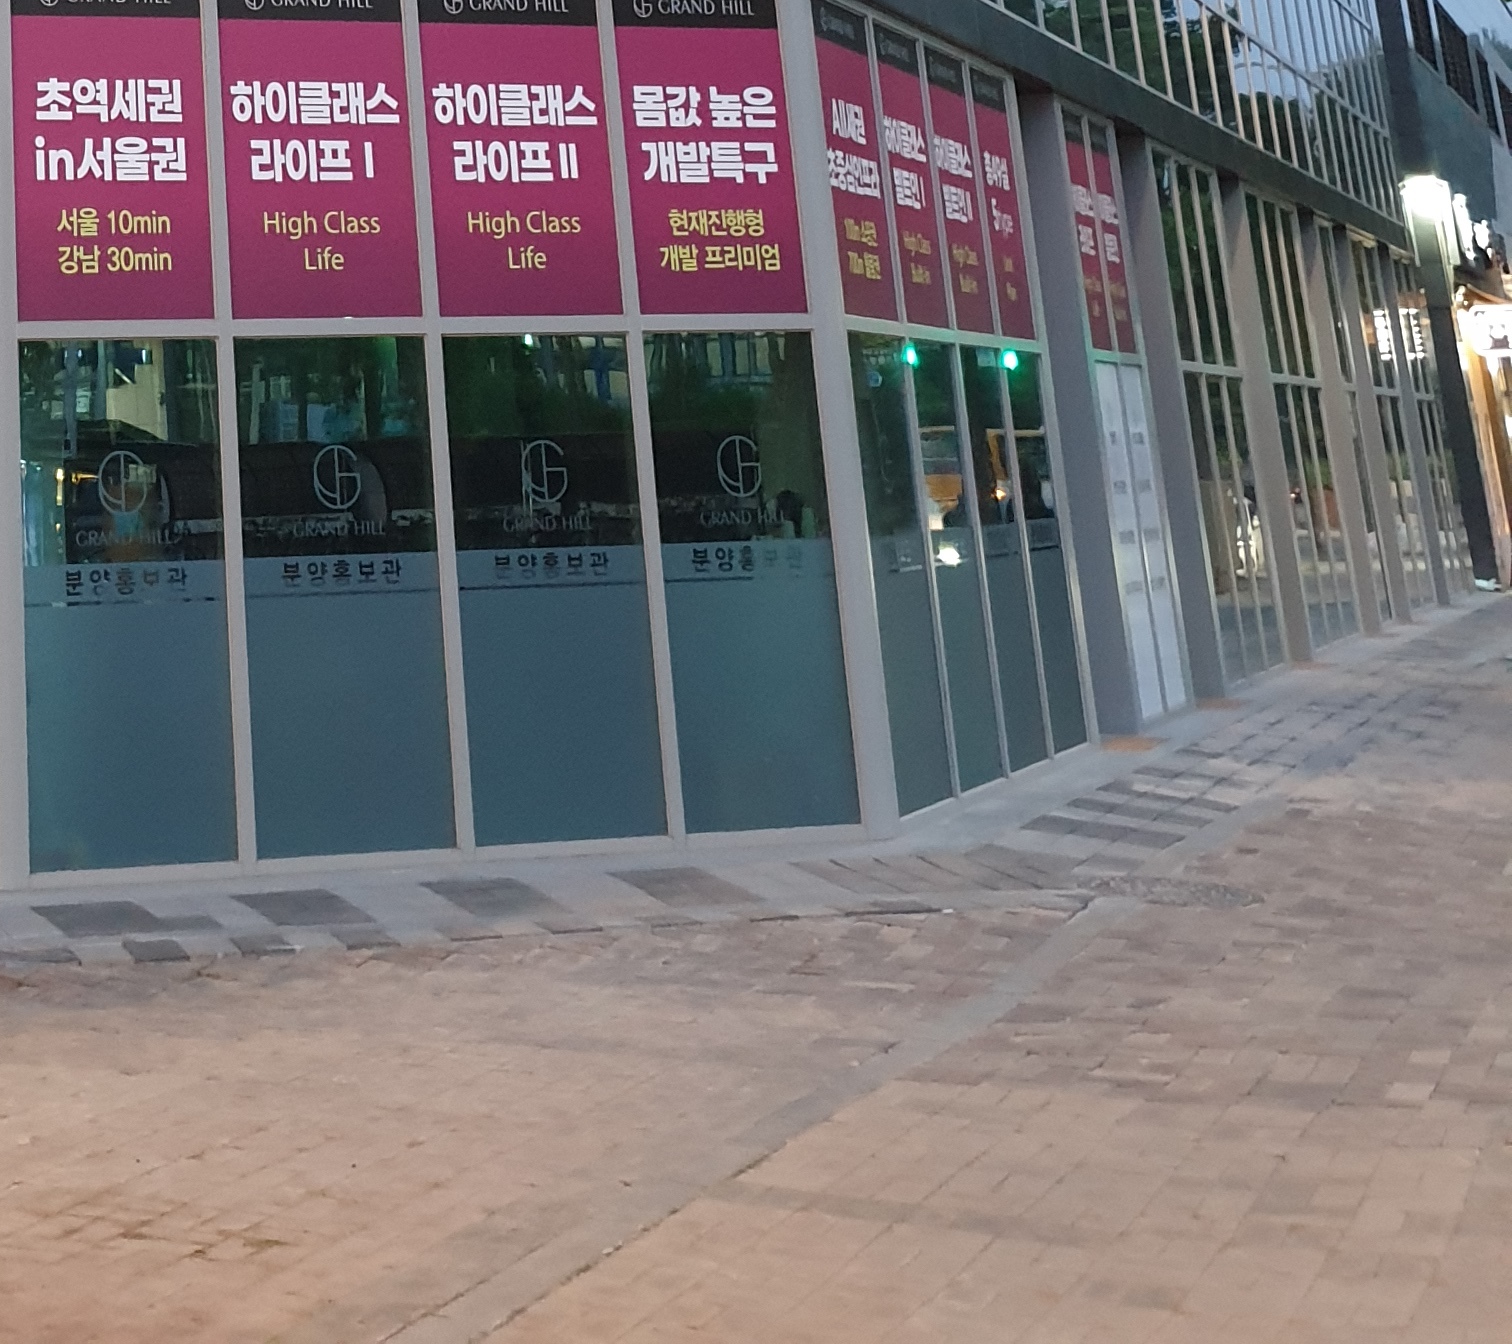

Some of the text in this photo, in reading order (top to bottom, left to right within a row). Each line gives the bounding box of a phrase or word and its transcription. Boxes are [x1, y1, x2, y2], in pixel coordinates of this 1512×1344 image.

[35, 77, 183, 123] 초역세권
[230, 80, 400, 125] 하이클래스
[432, 82, 598, 127] 하이클래스
[632, 85, 777, 129] 몸값 높은
[883, 114, 927, 163] 하이클래스
[34, 136, 187, 182] in서울권
[250, 138, 354, 183] 라이프
[452, 140, 554, 183] 라이프
[641, 141, 779, 184] 개발특구
[56, 208, 171, 237] 서울 10min
[263, 211, 381, 240] High Class
[467, 211, 581, 239] High Class
[668, 209, 765, 237] 현재진행형
[58, 246, 173, 274] 강남 30min
[304, 248, 345, 271] Life
[507, 246, 547, 269] Life
[659, 244, 781, 272] 개발 프리미엄
[282, 558, 403, 588] 분양홍보관
